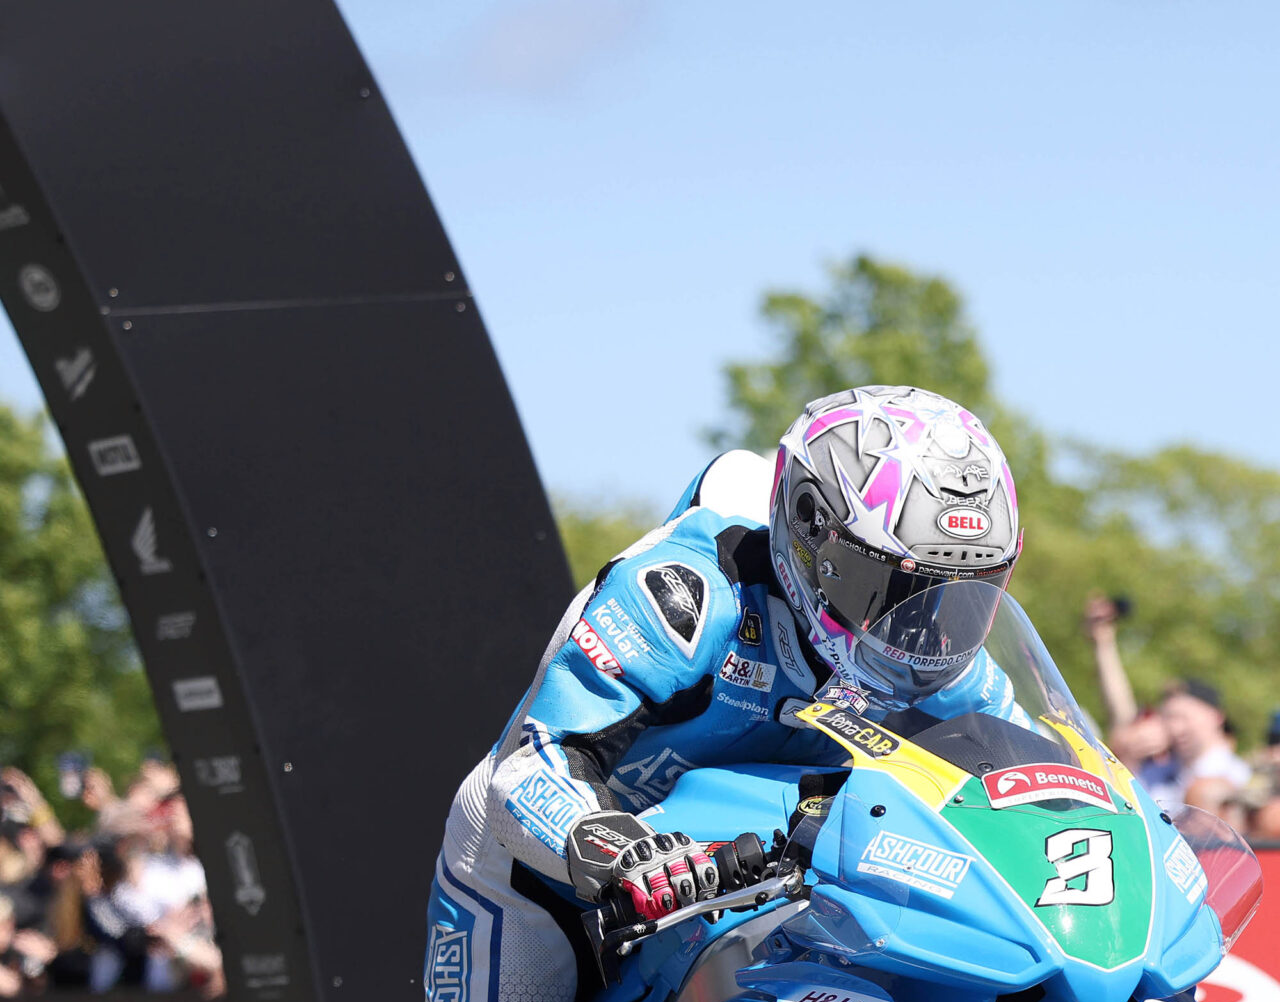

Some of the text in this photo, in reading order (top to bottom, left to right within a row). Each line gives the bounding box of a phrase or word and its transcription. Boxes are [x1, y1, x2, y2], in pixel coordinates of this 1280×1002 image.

[948, 516, 984, 530] BELL
[839, 538, 867, 555] NICHOLL
[869, 551, 886, 562] OILS
[779, 561, 796, 603] BELL
[919, 566, 974, 578] paceward.com
[592, 604, 639, 661] Kevlar
[607, 597, 651, 653] BUILT WITH
[571, 619, 624, 679] MOTUL
[778, 622, 804, 677] RST
[883, 645, 974, 667] RED TORPEDO.COM
[720, 668, 750, 686] MARTIN
[717, 693, 769, 715] Steelplan
[829, 712, 894, 754] fonaCAB
[1035, 772, 1105, 796] Bennetts
[512, 808, 567, 855] RACING
[582, 823, 633, 846] RST
[861, 830, 976, 887] ASHCOURT
[1034, 828, 1116, 908] 3
[867, 866, 942, 893] RACING
